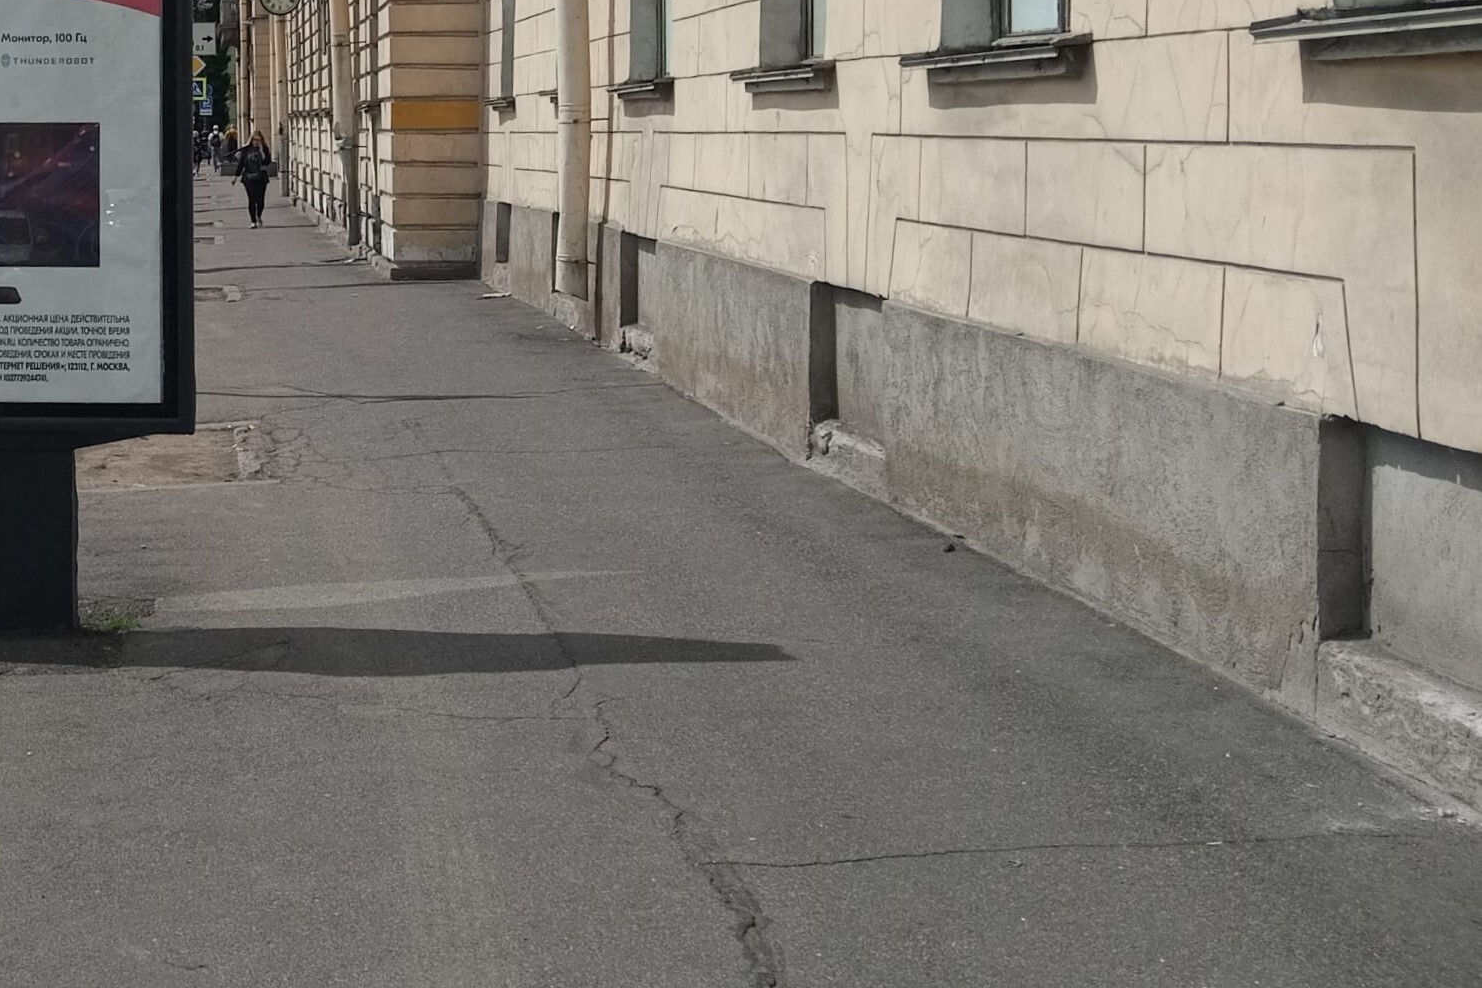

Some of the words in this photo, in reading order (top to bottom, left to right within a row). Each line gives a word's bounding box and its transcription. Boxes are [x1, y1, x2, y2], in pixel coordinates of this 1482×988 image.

[1, 33, 52, 44] Монитор,
[55, 33, 73, 43] 100
[75, 32, 88, 44] Гц
[3, 314, 48, 323] АКЦИОННАЯ
[50, 314, 69, 323] ЦЕНА
[70, 314, 130, 323] ДЕЙСТВИТЕЛЬНА
[10, 326, 53, 335] ПРОВЕДЕНИЯ
[81, 326, 106, 335] ТОЧНОЕ
[109, 326, 130, 335] ВРЕМЯ
[18, 338, 60, 347] КОЛИЧЕСТВО
[61, 338, 85, 347] ТОВАРА
[34, 350, 60, 358] СРОКАХ
[67, 350, 87, 359] МЕСТЕ
[88, 350, 130, 359] ПРОВЕДЕНИЯ
[96, 362, 130, 371] МОСКВА,
